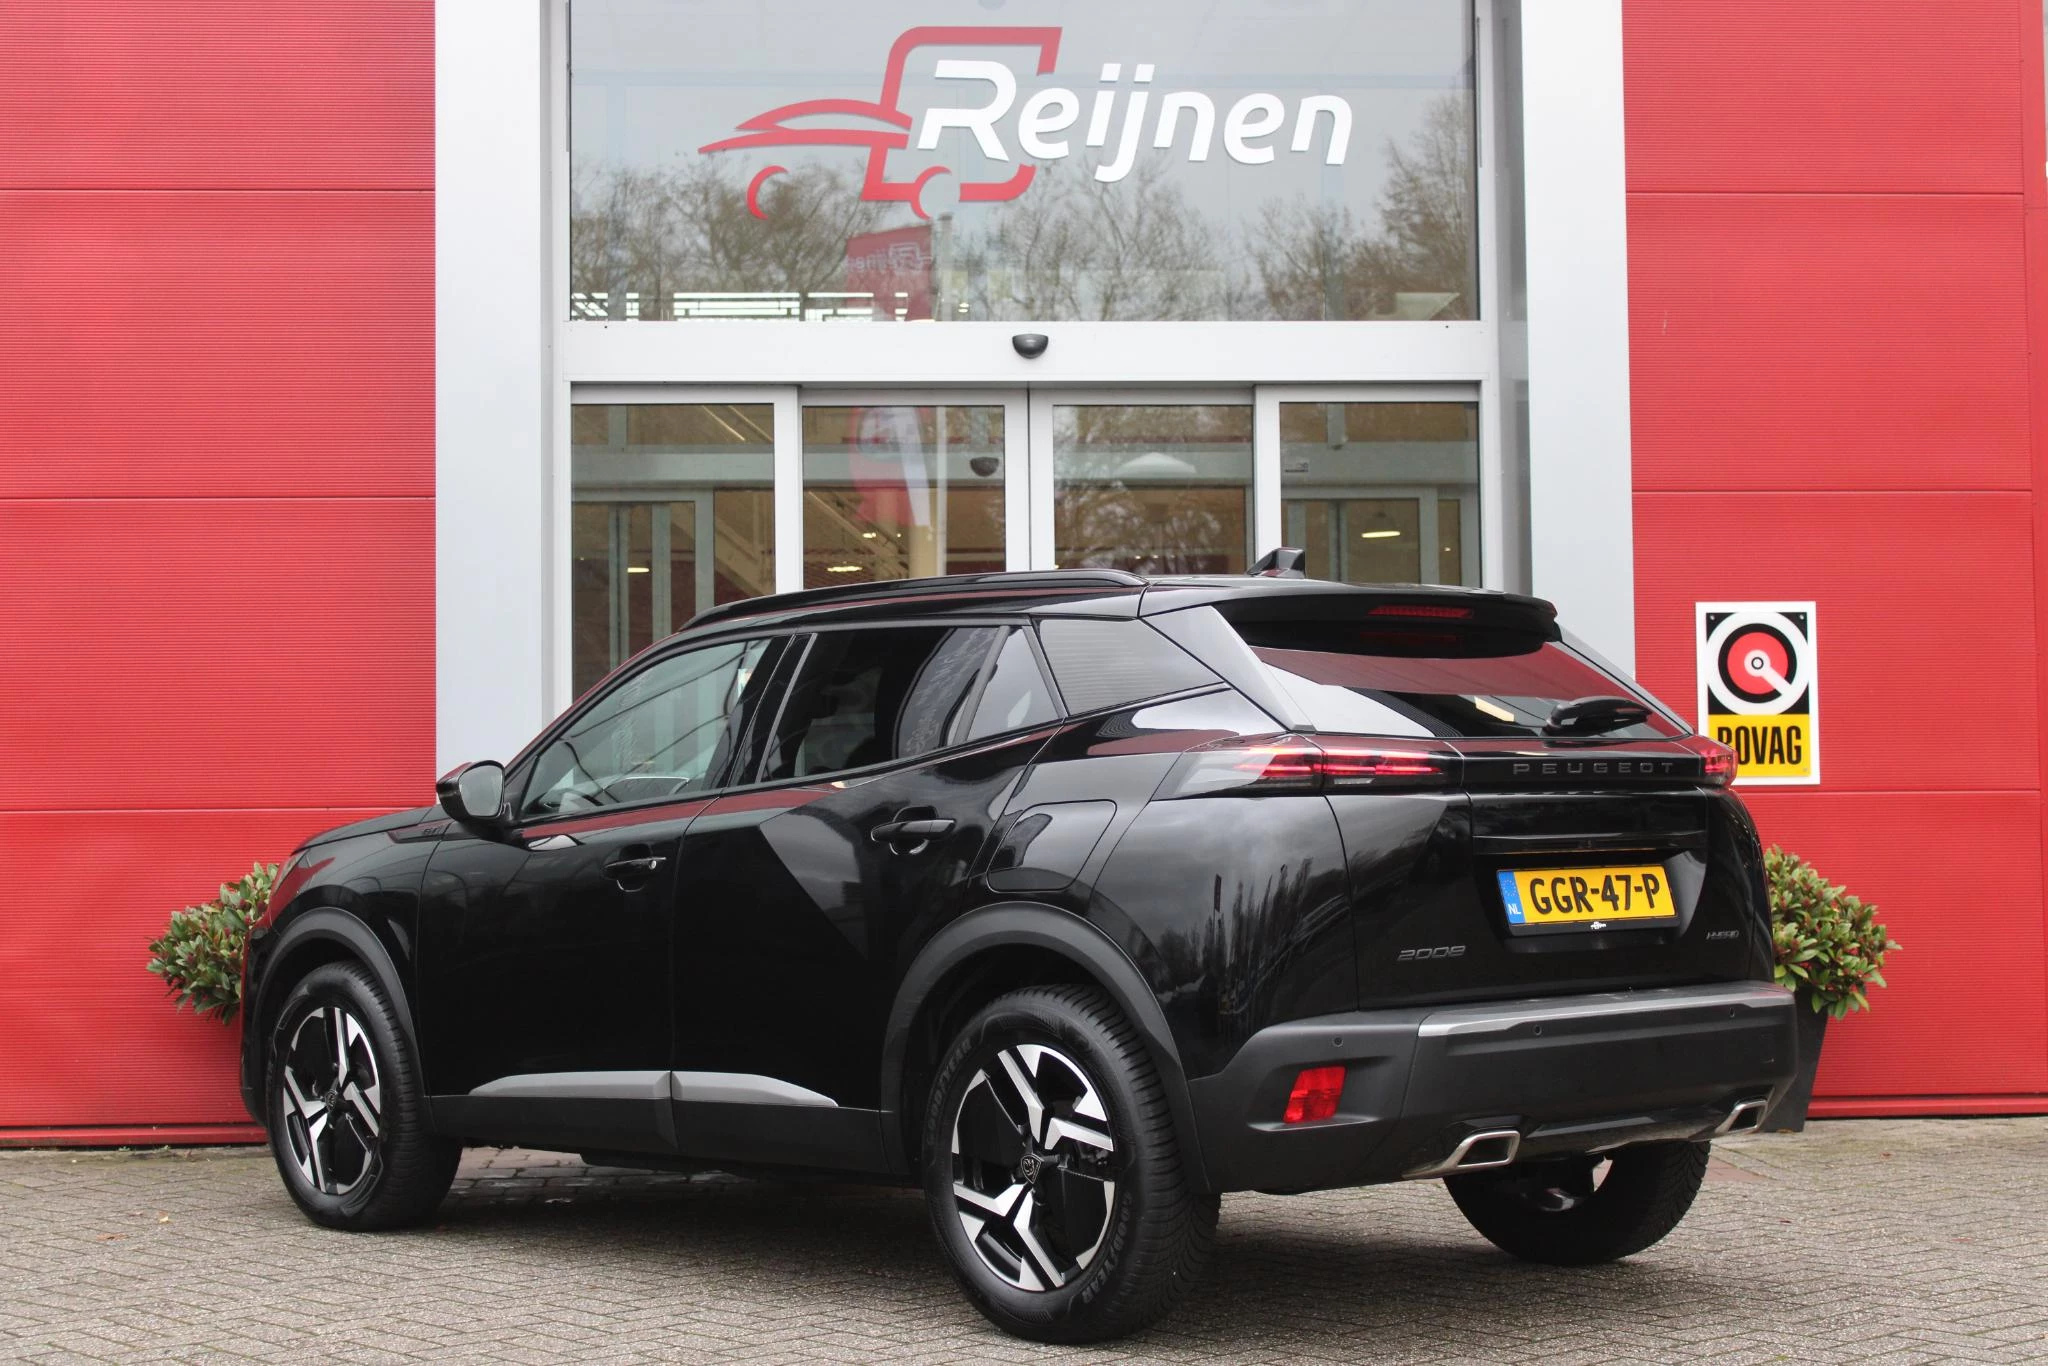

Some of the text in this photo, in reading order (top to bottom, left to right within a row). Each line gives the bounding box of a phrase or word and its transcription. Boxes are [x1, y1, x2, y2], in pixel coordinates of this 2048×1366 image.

[916, 59, 1353, 183] Reijnen
[1512, 762, 1674, 775] PEUGEOT
[1529, 873, 1660, 915] GGR-47-P
[1508, 903, 1522, 915] NL
[1397, 945, 1466, 961] 2008
